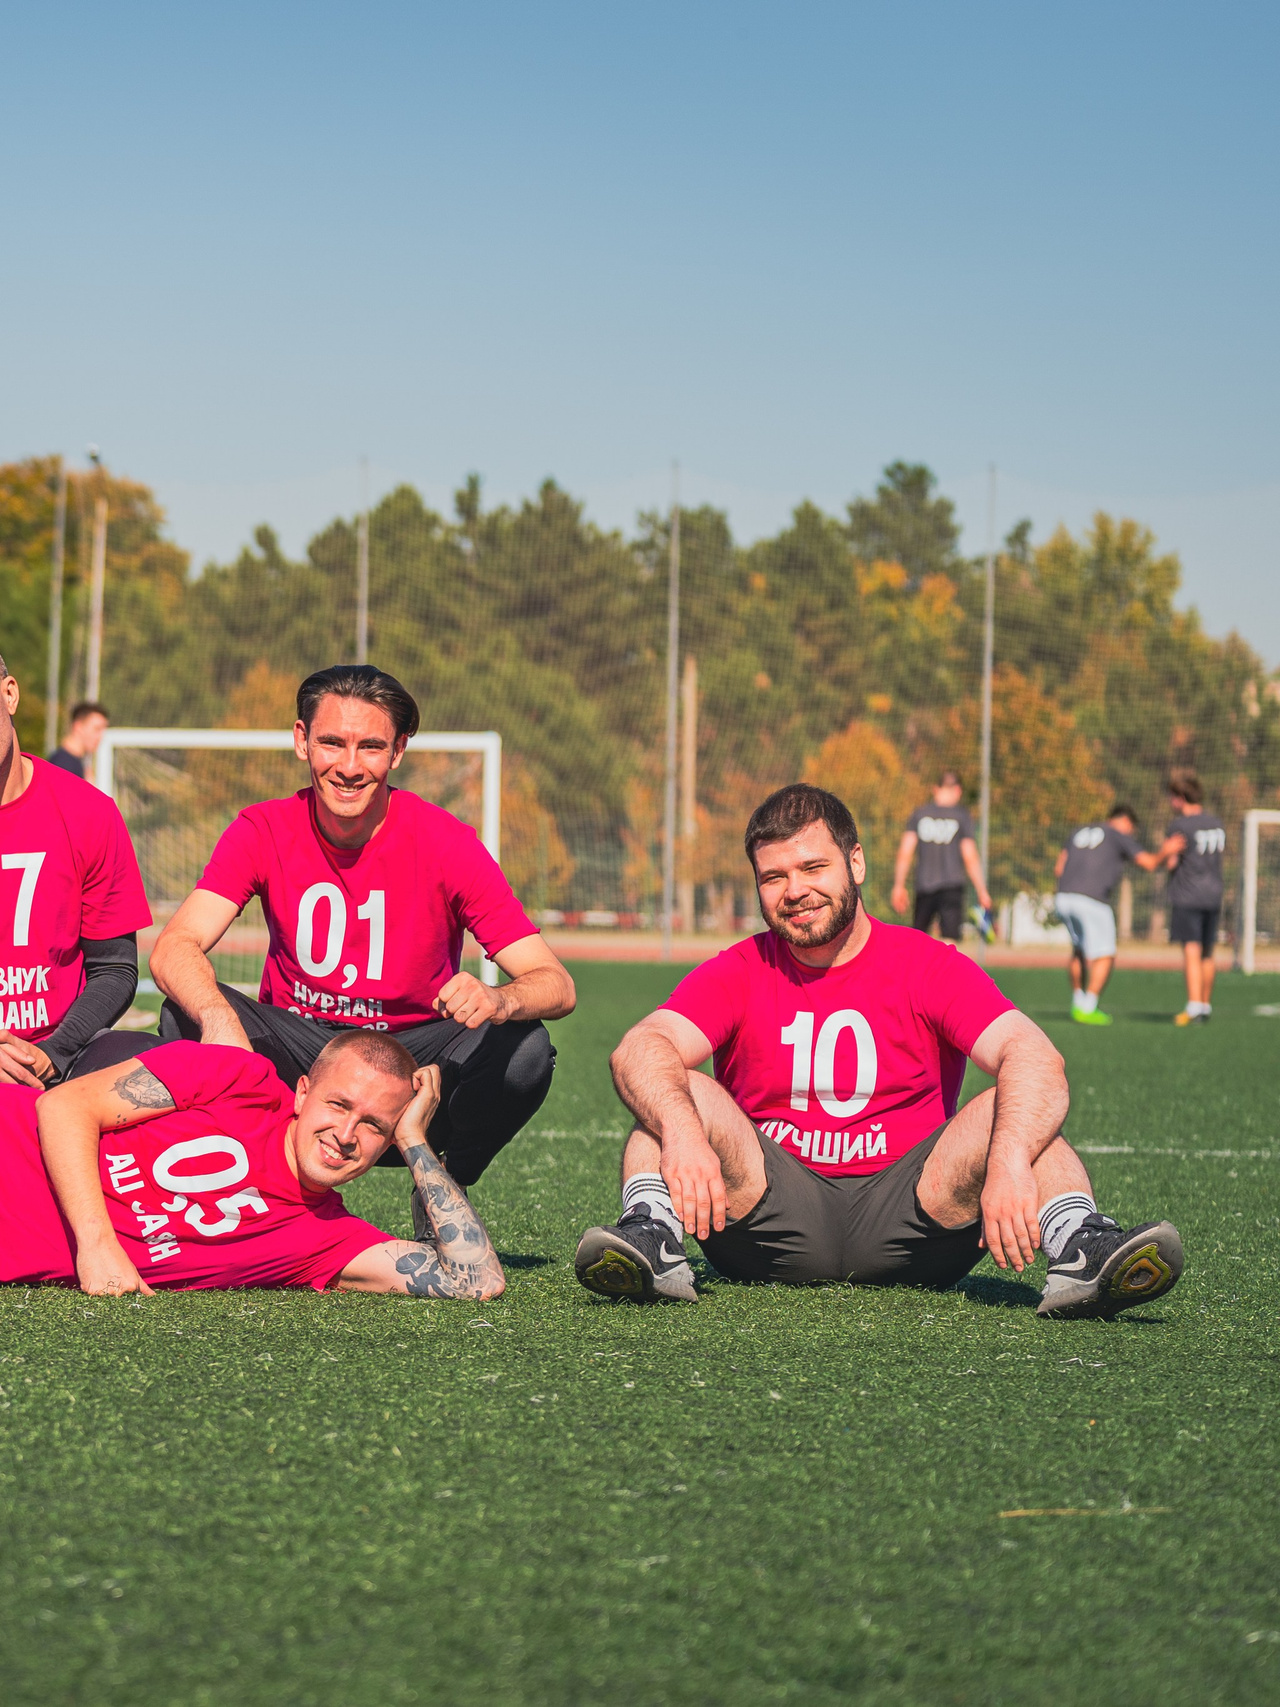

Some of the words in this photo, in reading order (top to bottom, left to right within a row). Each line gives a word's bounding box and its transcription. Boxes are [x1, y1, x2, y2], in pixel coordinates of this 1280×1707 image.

[296, 882, 385, 989] 0,1
[294, 980, 383, 1018] НУРЛАН
[781, 1009, 878, 1118] 10
[152, 1135, 270, 1236] 0,5
